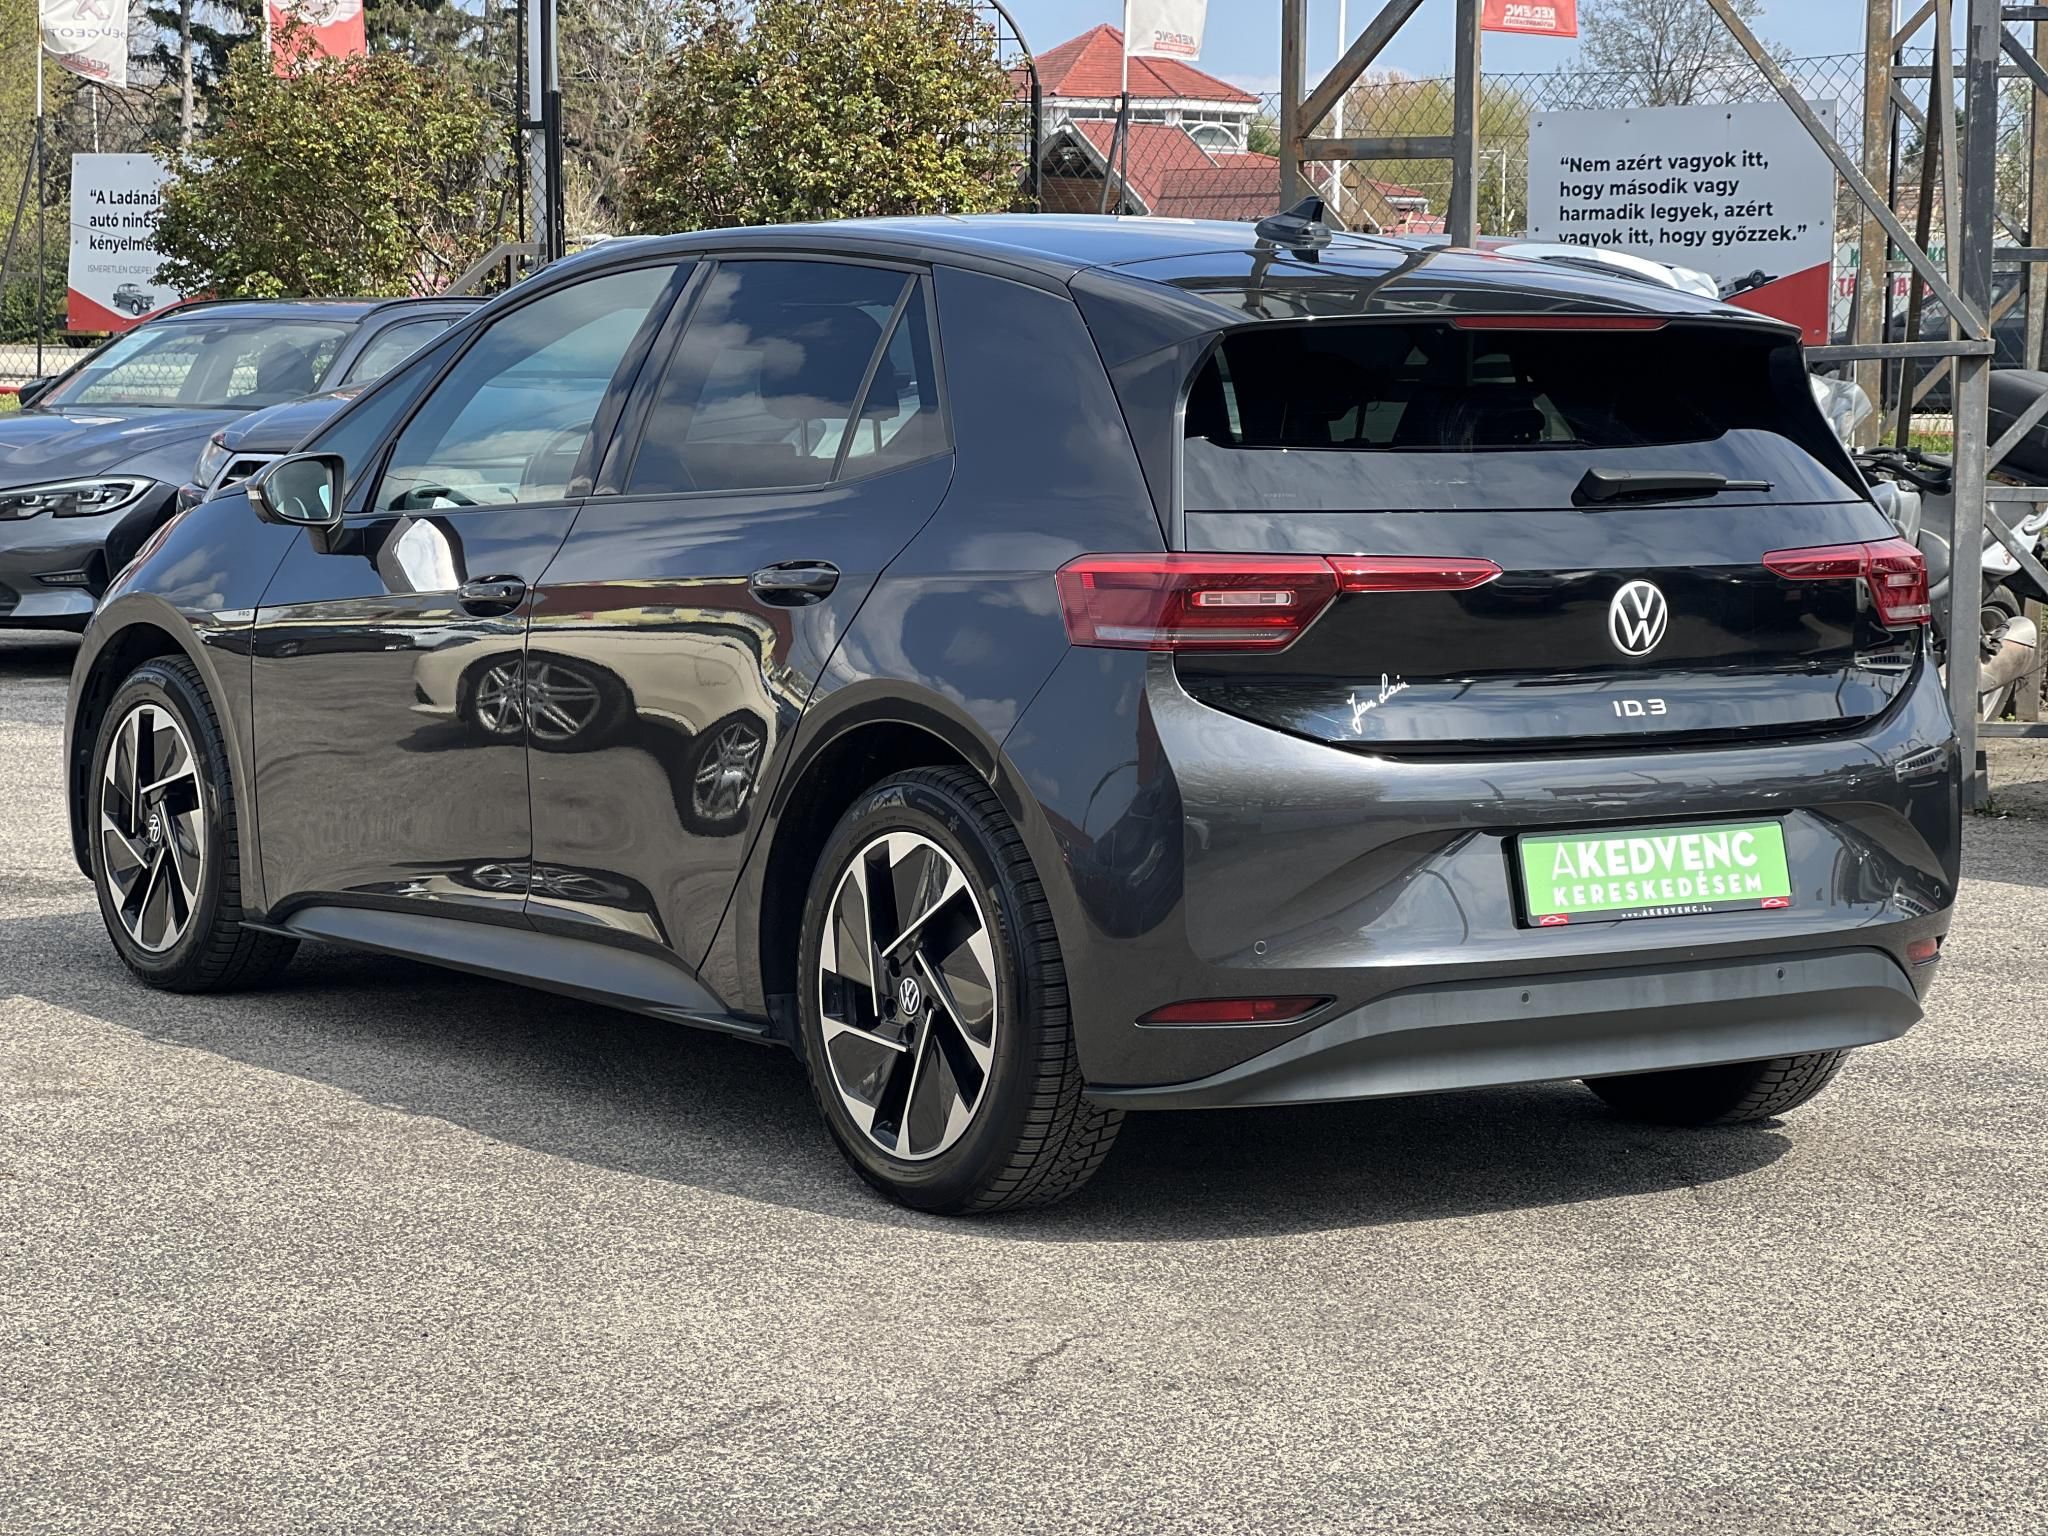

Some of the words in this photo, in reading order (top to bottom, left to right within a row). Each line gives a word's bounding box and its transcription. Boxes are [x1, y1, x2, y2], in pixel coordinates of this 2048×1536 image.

[1615, 154, 1663, 171] azért
[1667, 152, 1737, 173] vagyok
[1742, 150, 1769, 170] itt,
[109, 189, 161, 205] Ladánál
[1560, 181, 1605, 201] hogy
[1609, 177, 1688, 196] második
[1693, 180, 1740, 197] vagy
[89, 212, 119, 228] autó
[122, 212, 158, 229] nincs
[1559, 203, 1645, 222] harmadik
[1650, 202, 1719, 223] legyek,
[1724, 200, 1774, 218] azért
[1558, 229, 1623, 248] vagyok
[1628, 227, 1654, 247] itt,
[1659, 228, 1708, 247] hogy
[1553, 871, 1763, 907] KERESKEDÉSEM
